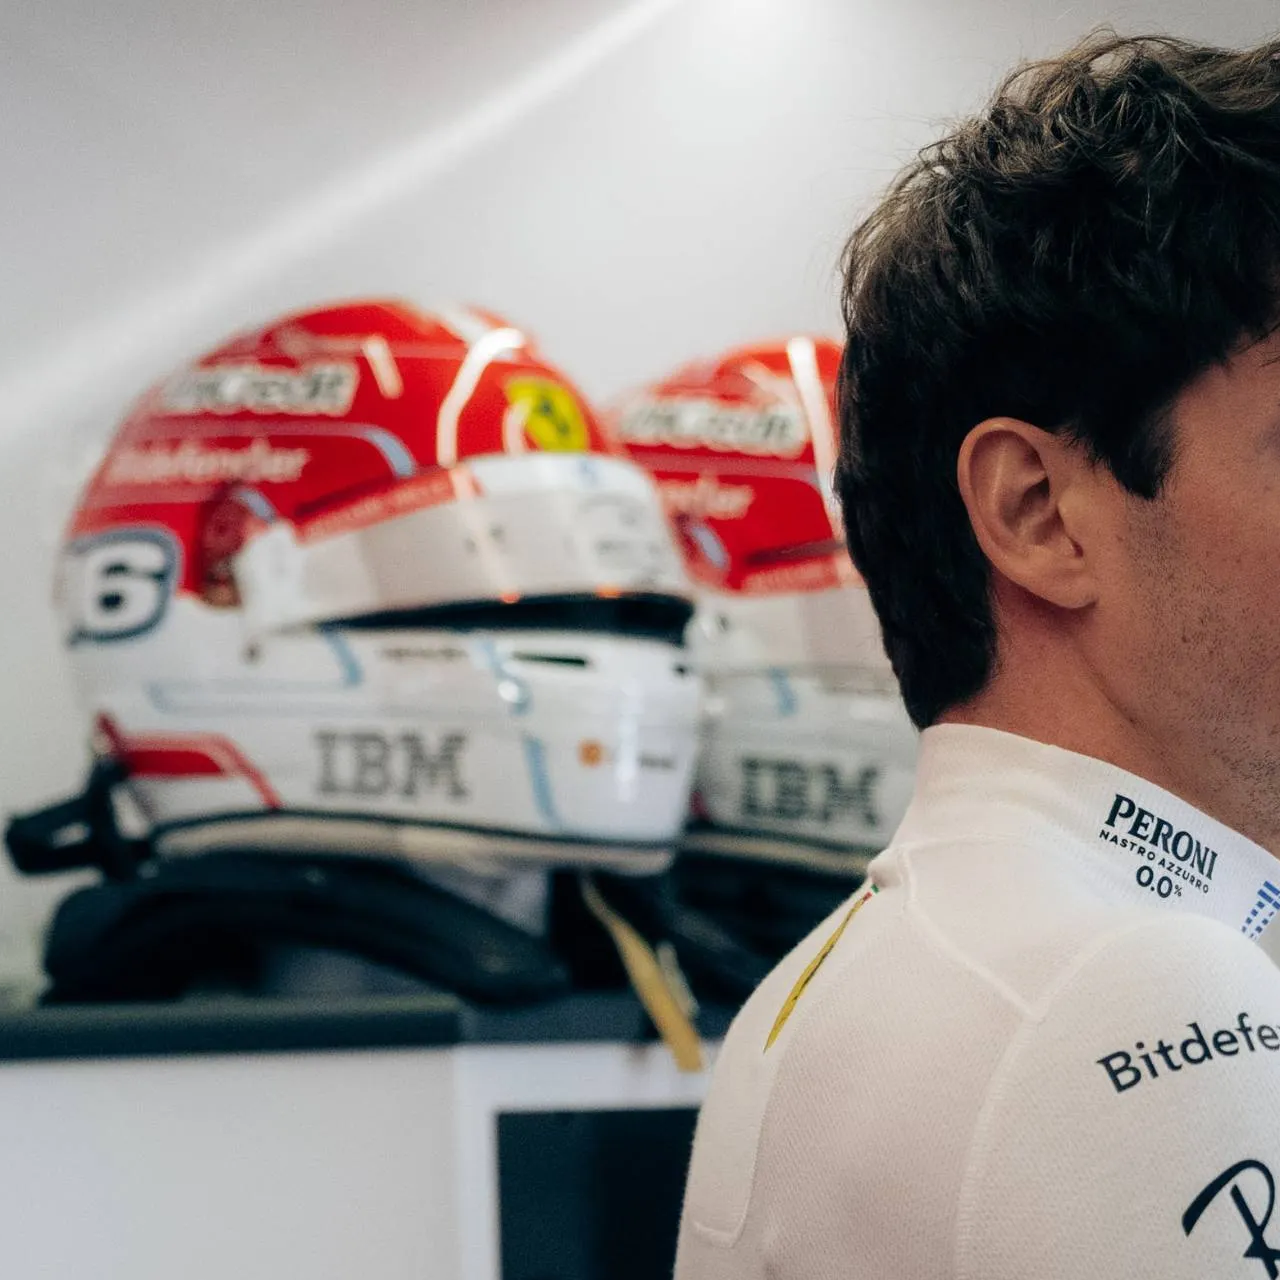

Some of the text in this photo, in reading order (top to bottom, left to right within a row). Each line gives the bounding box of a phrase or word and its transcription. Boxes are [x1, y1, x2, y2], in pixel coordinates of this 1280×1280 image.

[314, 731, 469, 798] IBM
[740, 757, 880, 828] IBM
[1098, 829, 1209, 894] NASTRO AZZURRO
[1104, 793, 1219, 881] PERONI
[1135, 865, 1182, 899] 0.0%
